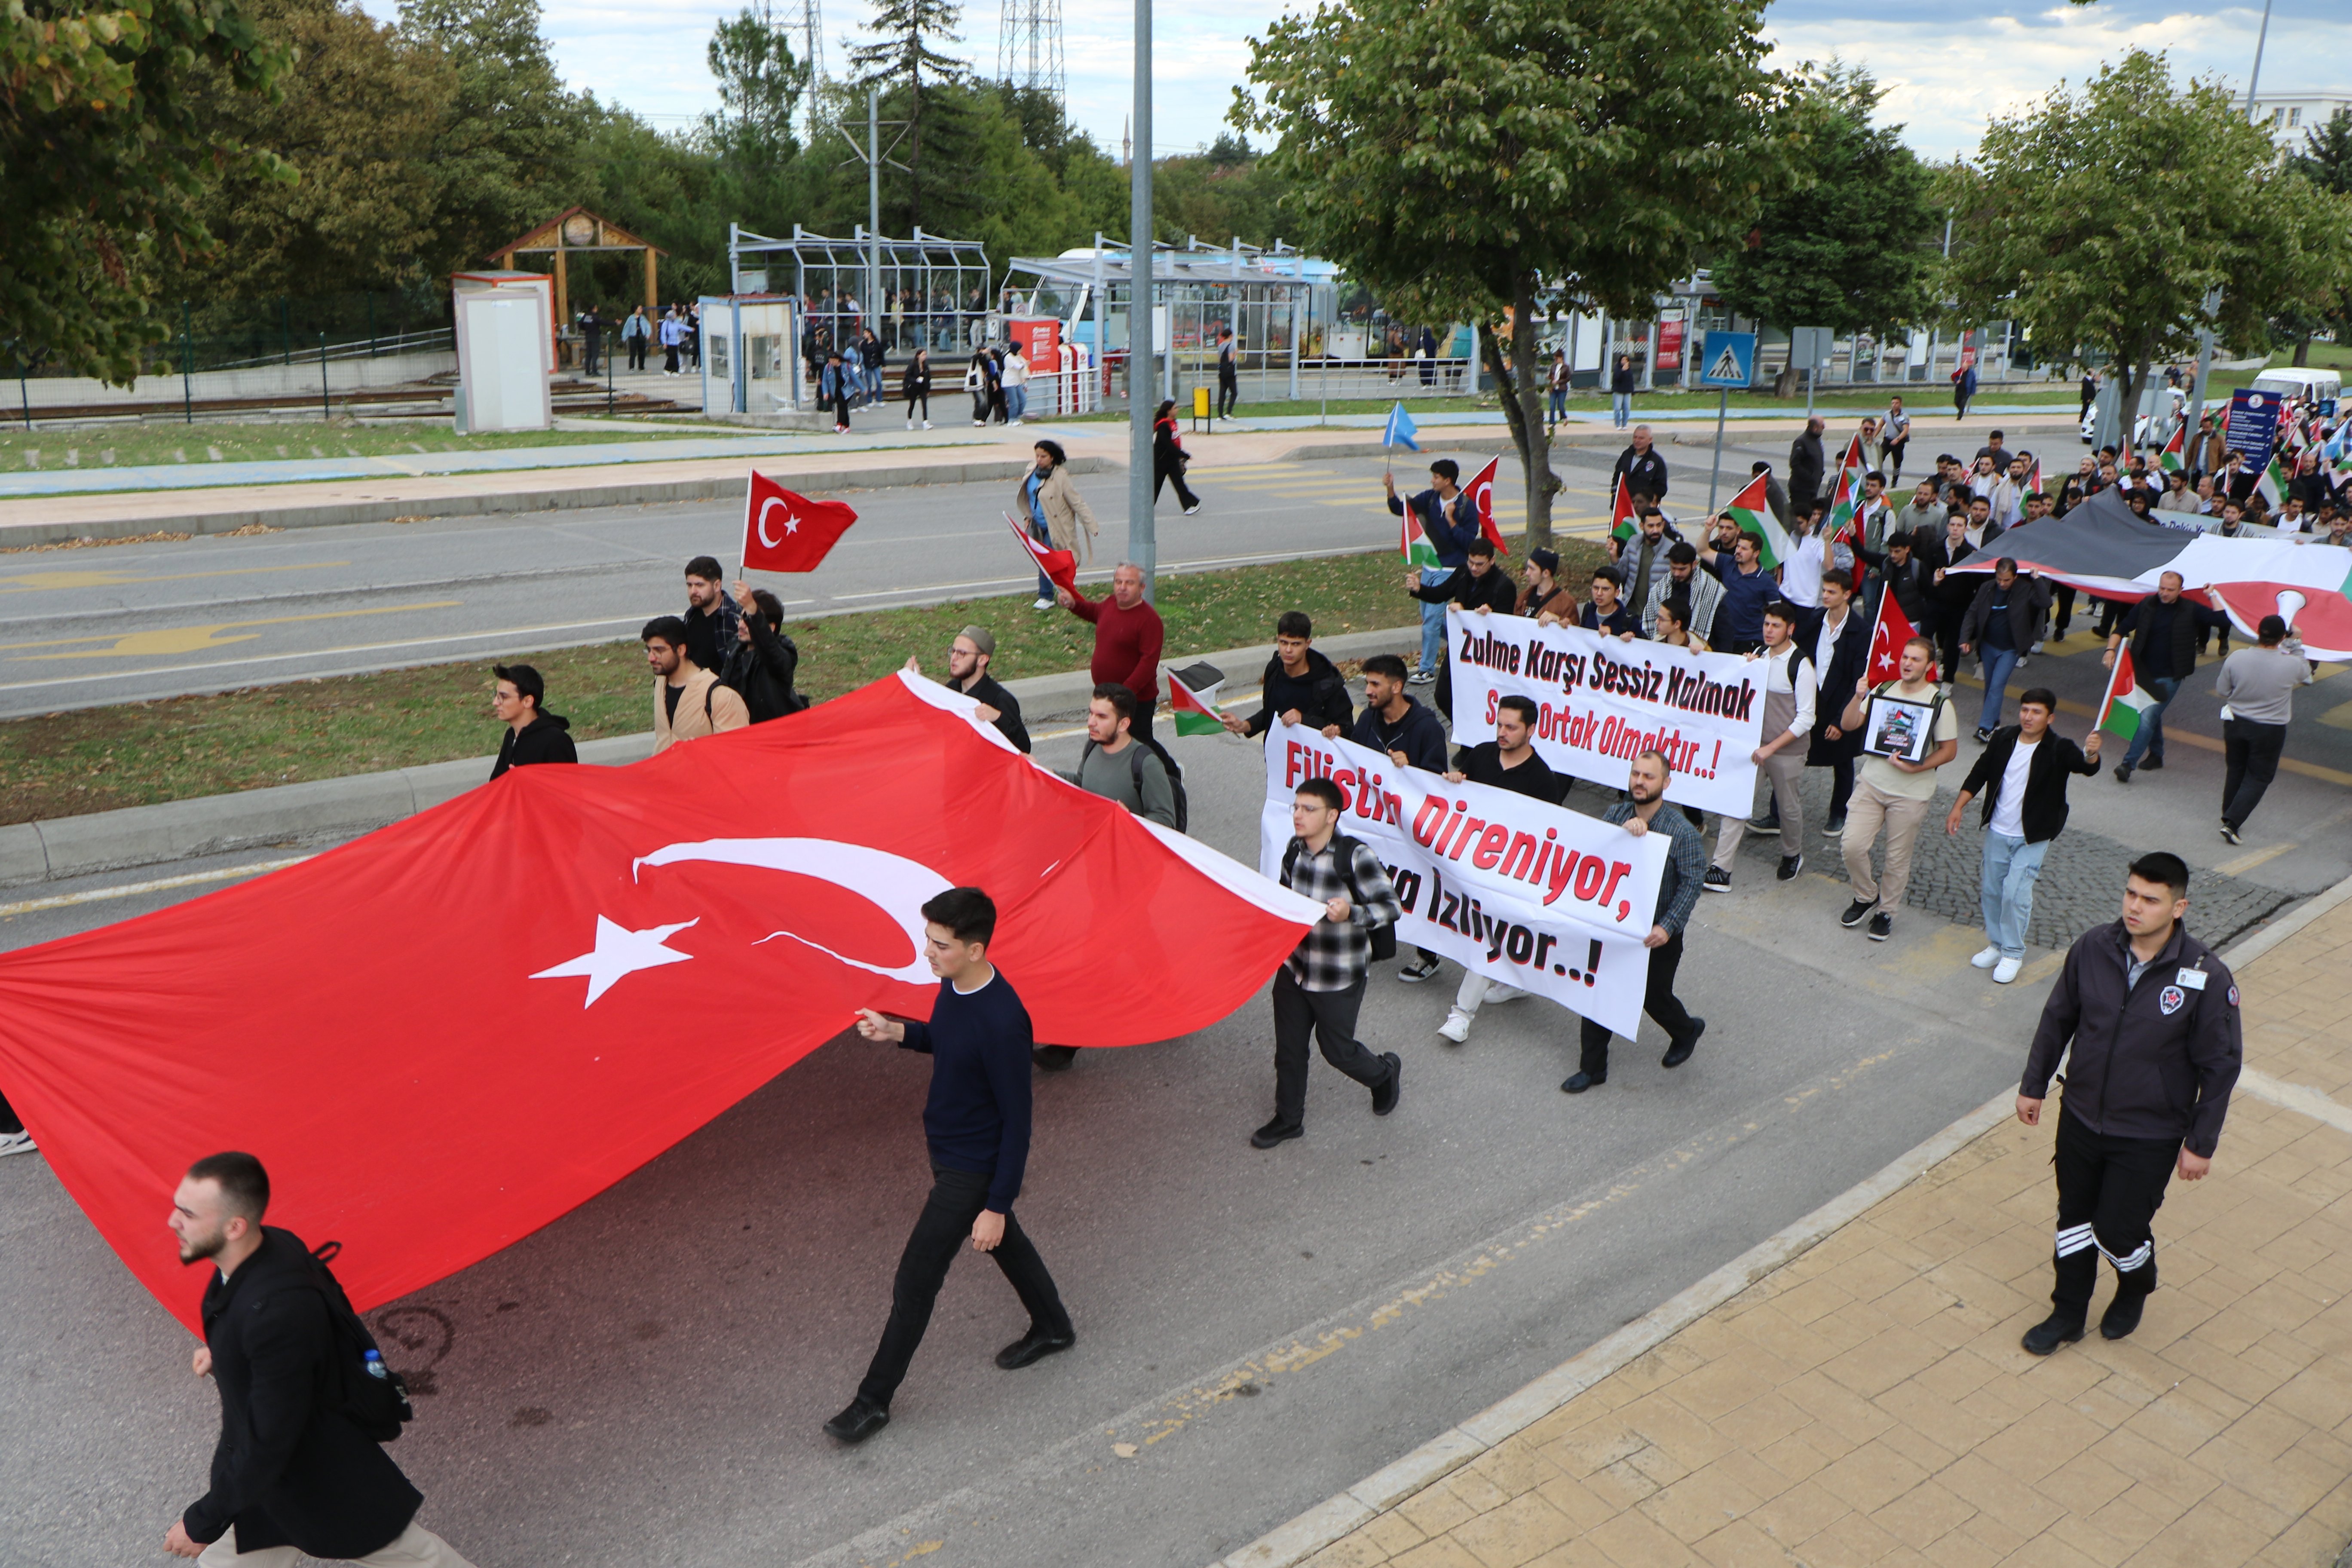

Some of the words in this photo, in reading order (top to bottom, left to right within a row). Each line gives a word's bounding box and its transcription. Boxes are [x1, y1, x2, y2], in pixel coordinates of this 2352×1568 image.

[1460, 628, 1520, 674] Zulme
[1524, 640, 1586, 694] Karşı
[1589, 651, 1663, 702] Sessiz
[1664, 666, 1756, 722] Kalmak
[1538, 702, 1599, 750] Ortak
[1412, 793, 1632, 922] Direniyor,
[1427, 867, 1602, 987] İzliyor..!
